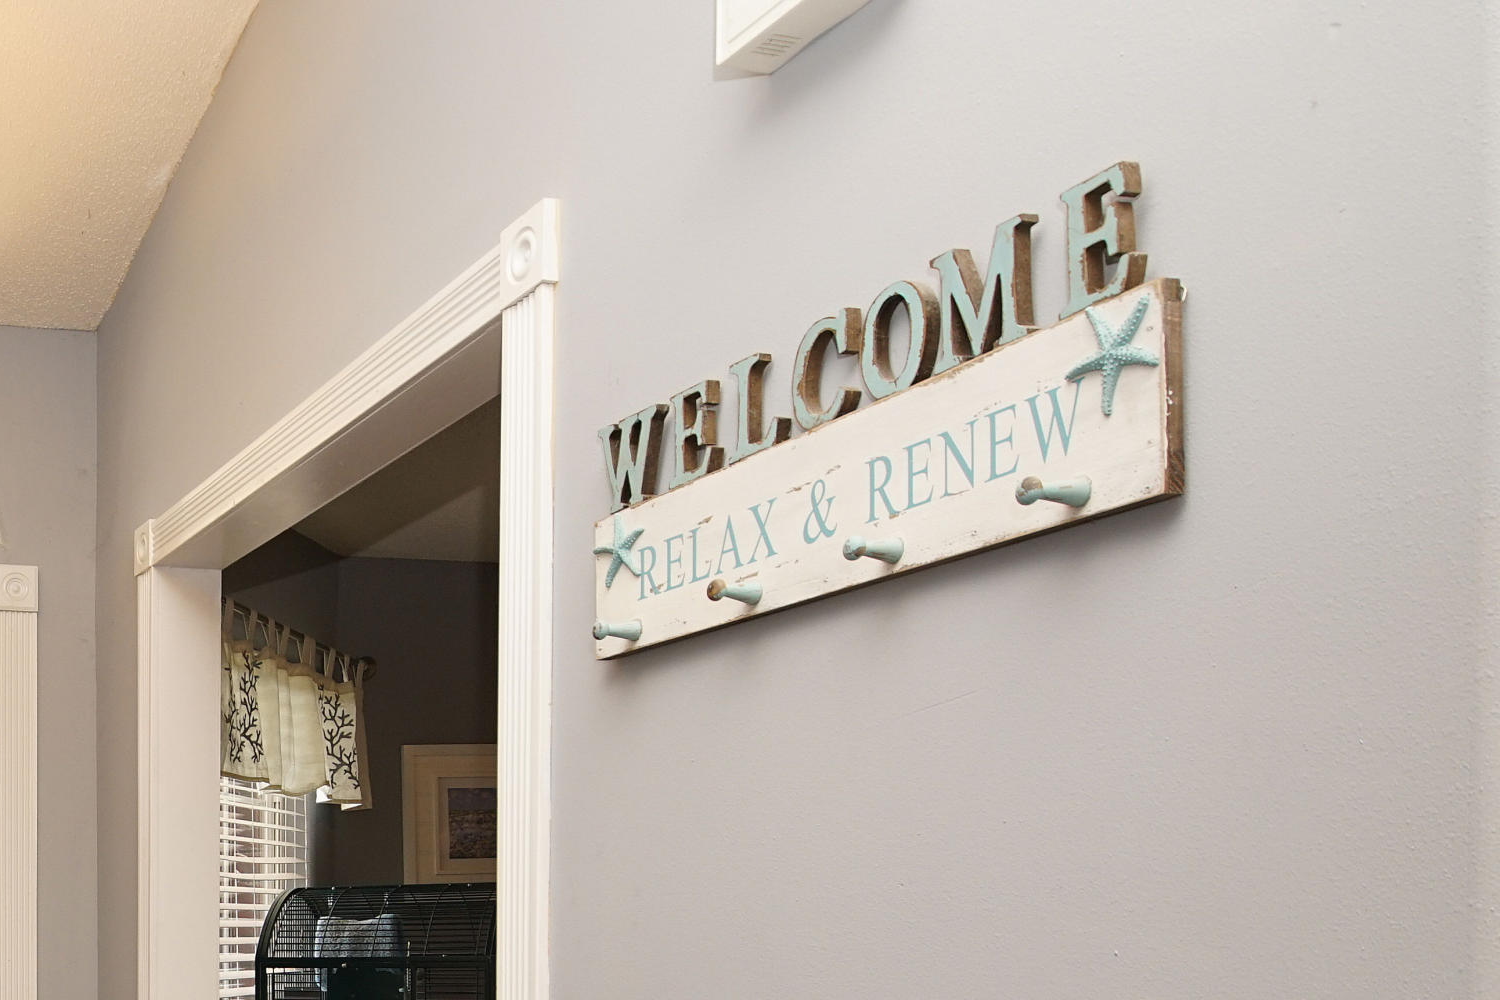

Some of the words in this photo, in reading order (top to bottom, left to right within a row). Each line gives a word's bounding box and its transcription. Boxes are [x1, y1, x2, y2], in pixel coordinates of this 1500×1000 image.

[598, 161, 1148, 513] WELCOME
[637, 497, 778, 600] RELAX
[802, 479, 837, 544] &
[864, 377, 1085, 524] RENEW
